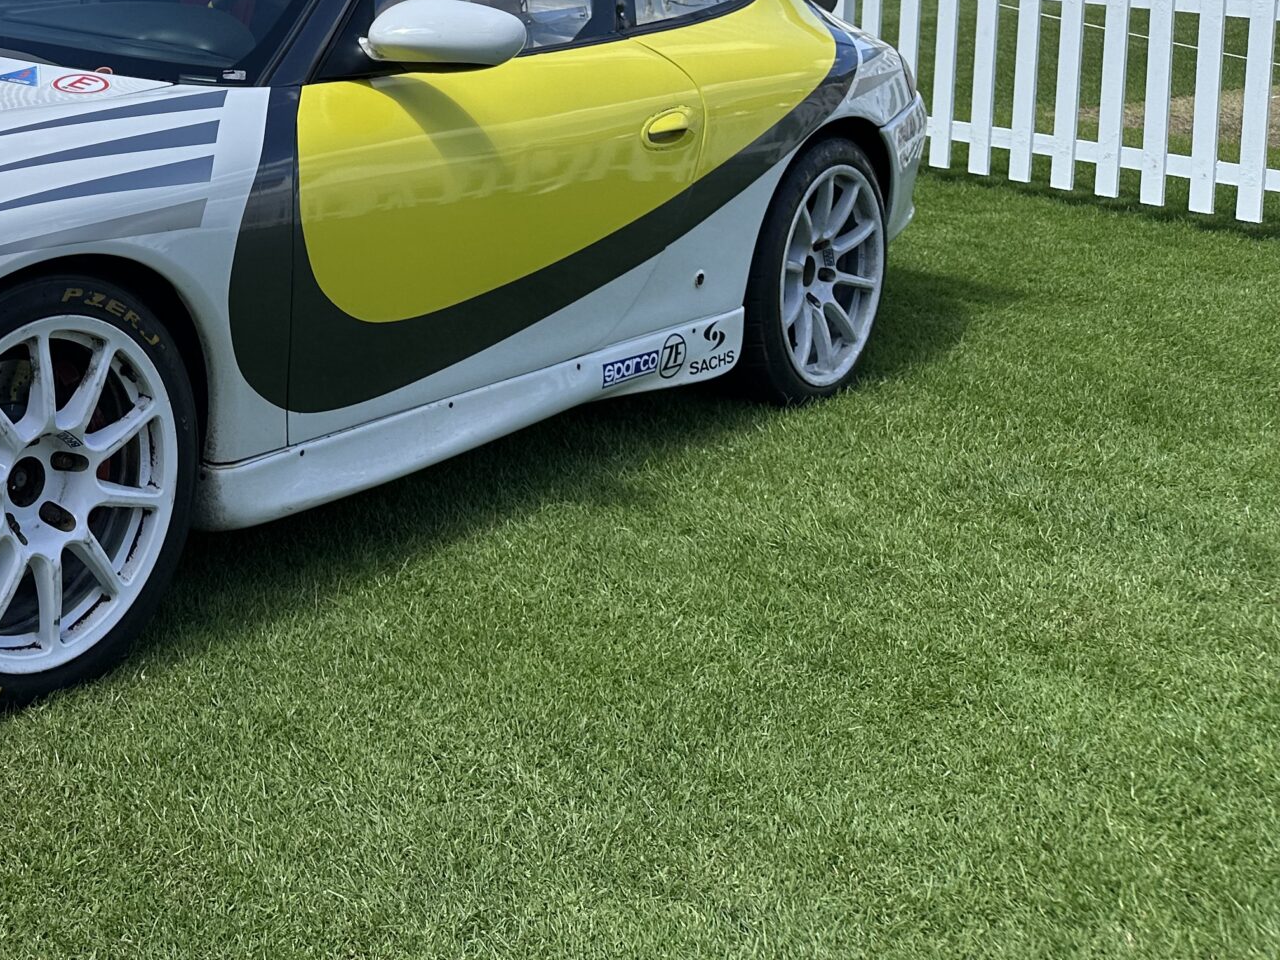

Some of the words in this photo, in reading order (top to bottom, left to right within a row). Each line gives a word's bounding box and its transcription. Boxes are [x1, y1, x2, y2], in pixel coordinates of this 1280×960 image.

[67, 76, 99, 90] E
[604, 351, 658, 385] sparco
[662, 343, 682, 372] ZF
[689, 350, 734, 375] SACHS
